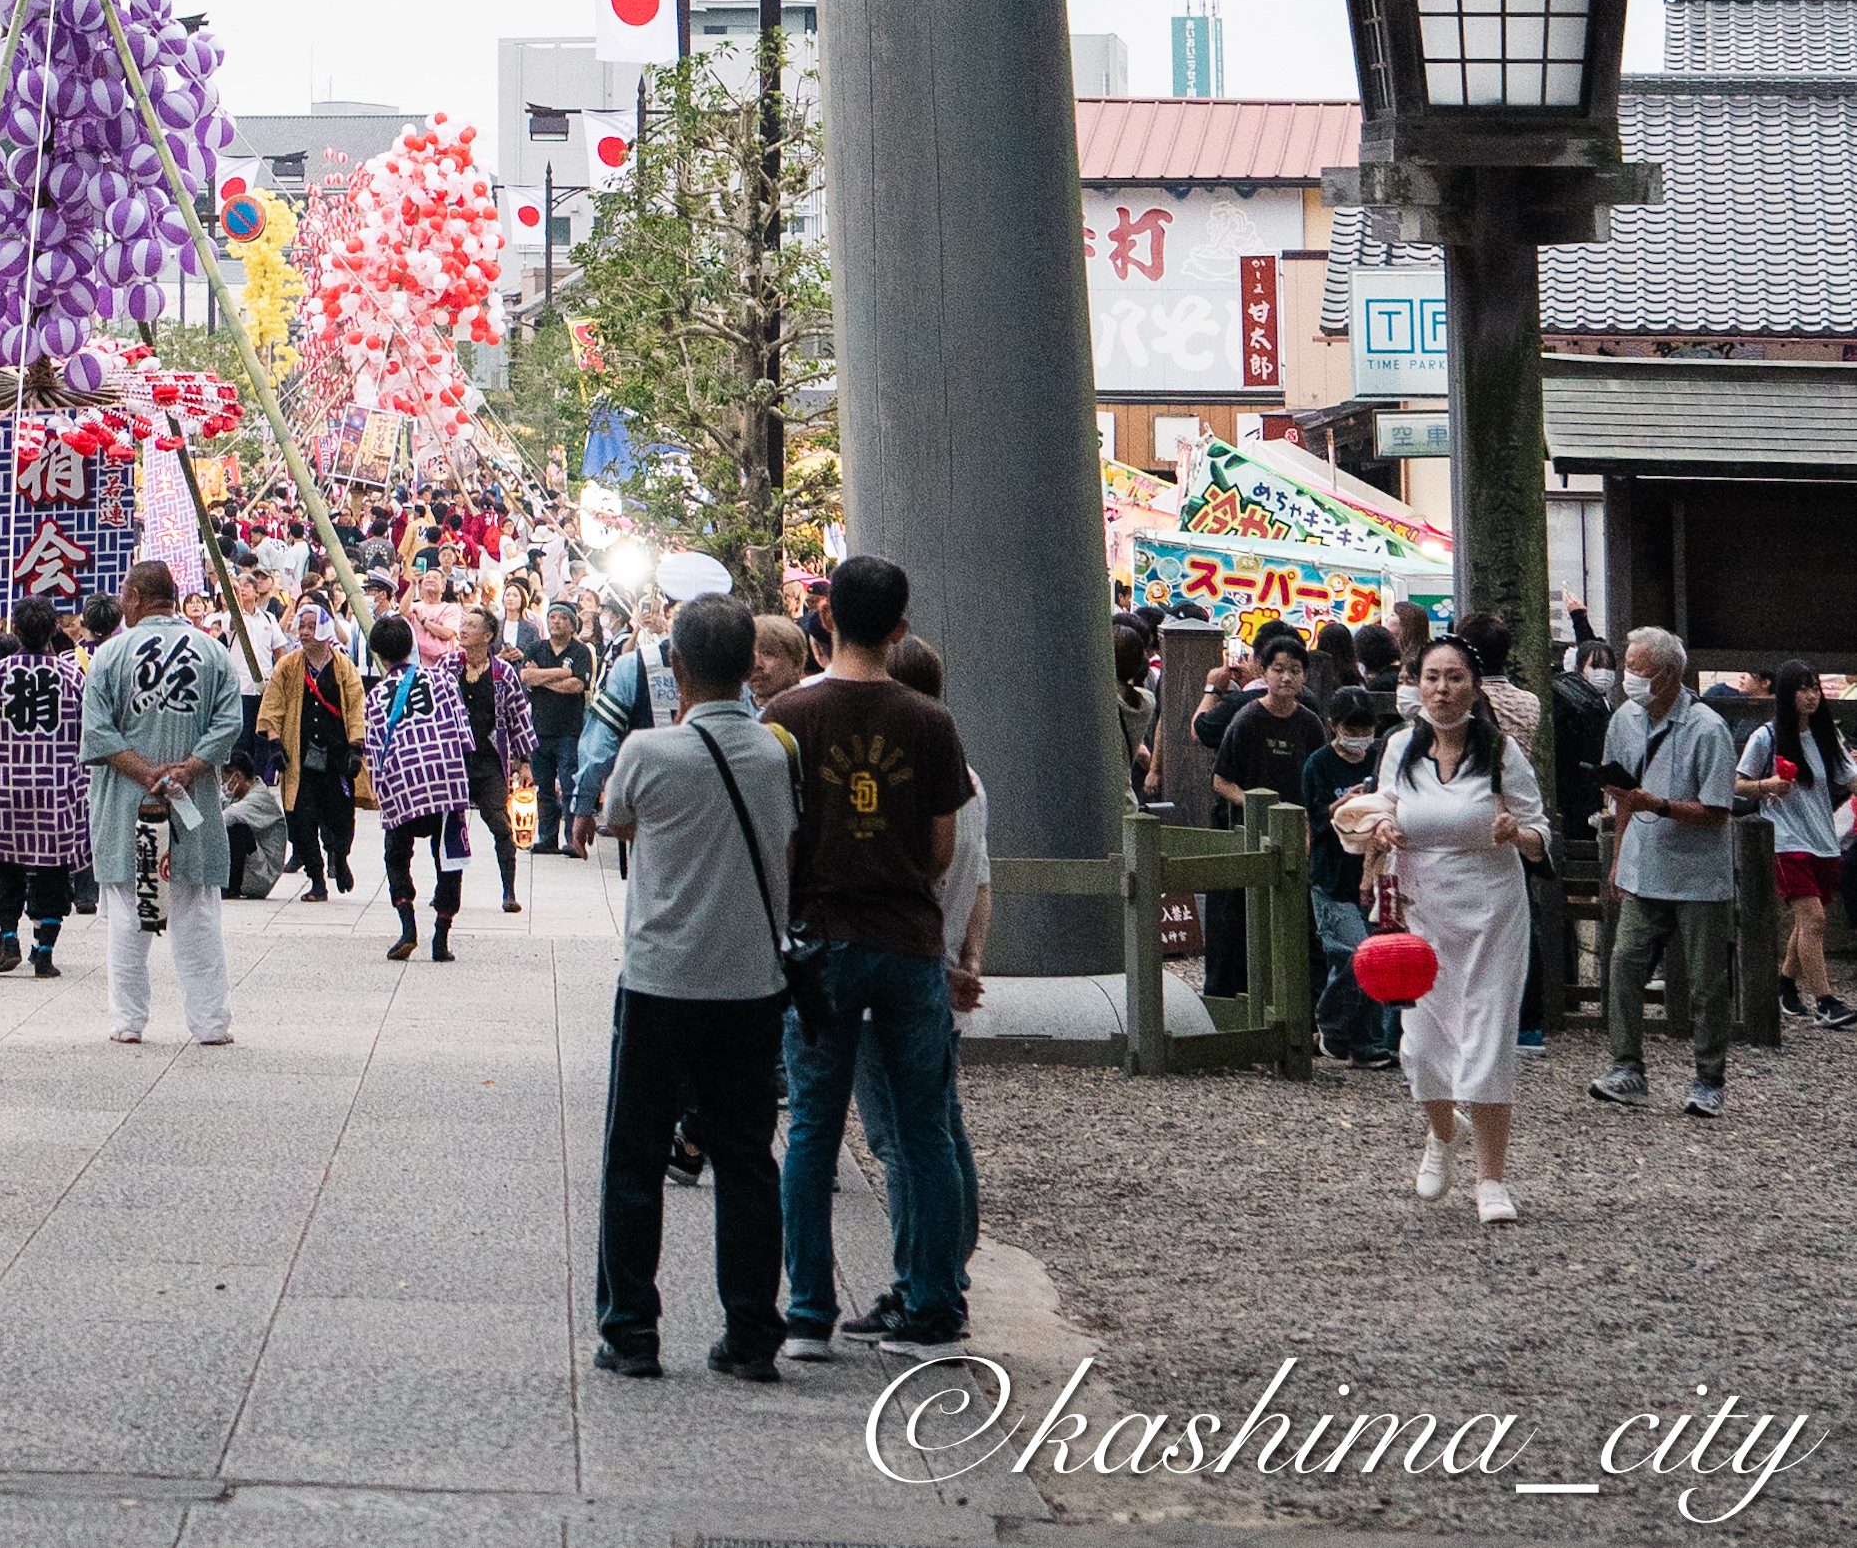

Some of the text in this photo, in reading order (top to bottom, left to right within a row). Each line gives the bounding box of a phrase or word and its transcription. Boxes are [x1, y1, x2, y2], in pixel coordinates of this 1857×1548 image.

[1368, 359, 1400, 370] TIME
[1185, 559, 1333, 609] スーパー
[849, 771, 878, 812] SD
